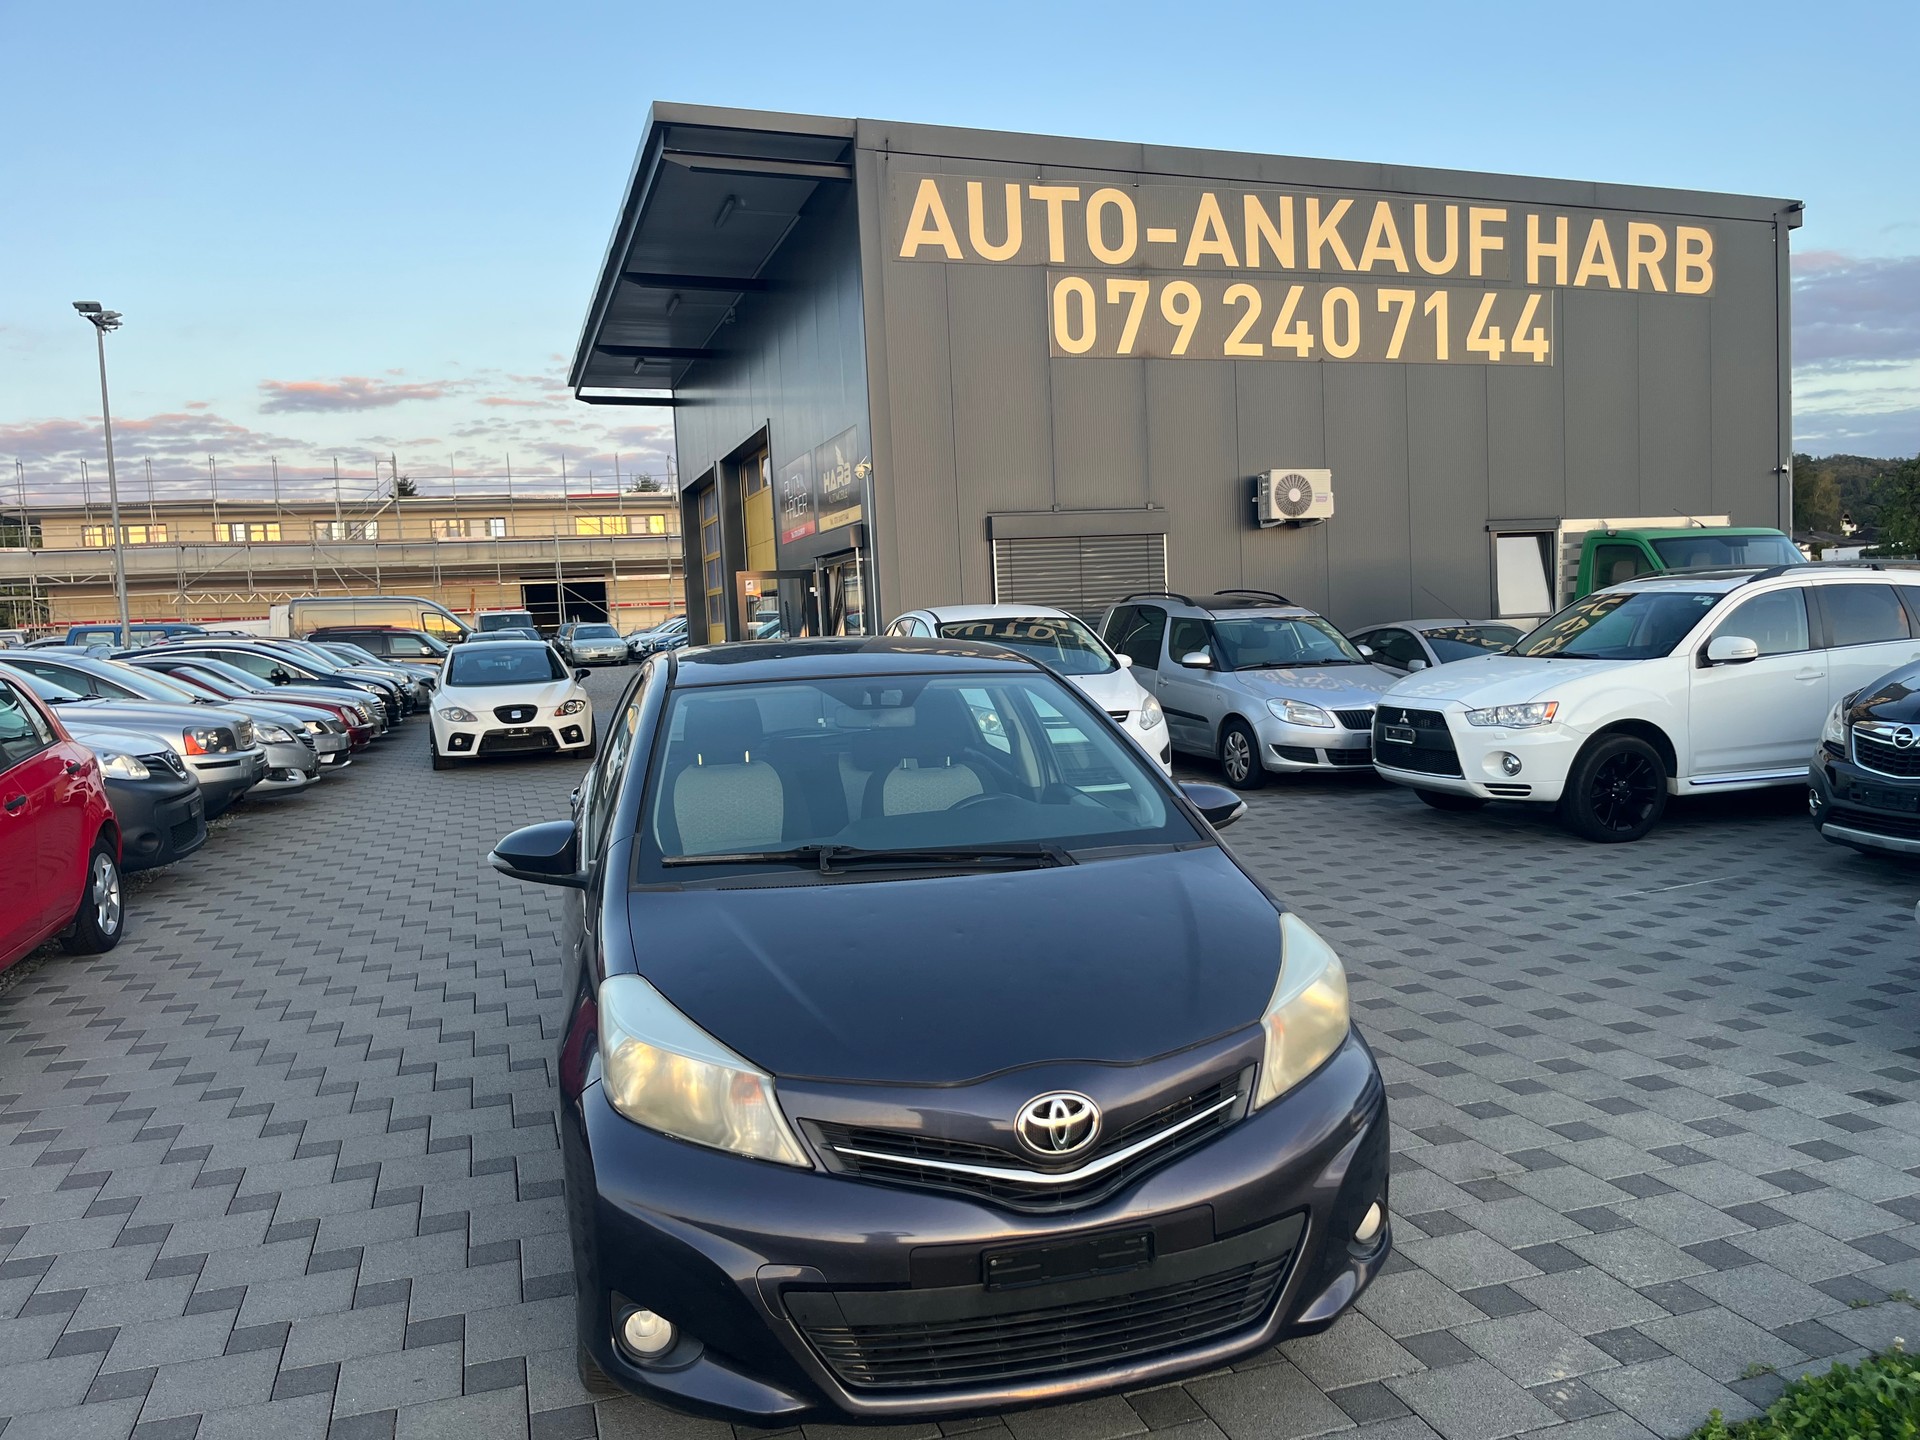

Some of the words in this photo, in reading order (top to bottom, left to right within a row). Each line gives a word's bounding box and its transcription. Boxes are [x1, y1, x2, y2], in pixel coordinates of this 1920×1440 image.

[899, 178, 1507, 276] AUTO-ANKAUF
[1526, 214, 1714, 295] HARB
[1053, 276, 1202, 356] 079
[1222, 283, 1361, 359] 240
[1466, 292, 1550, 363] 44
[823, 462, 851, 494] HARB
